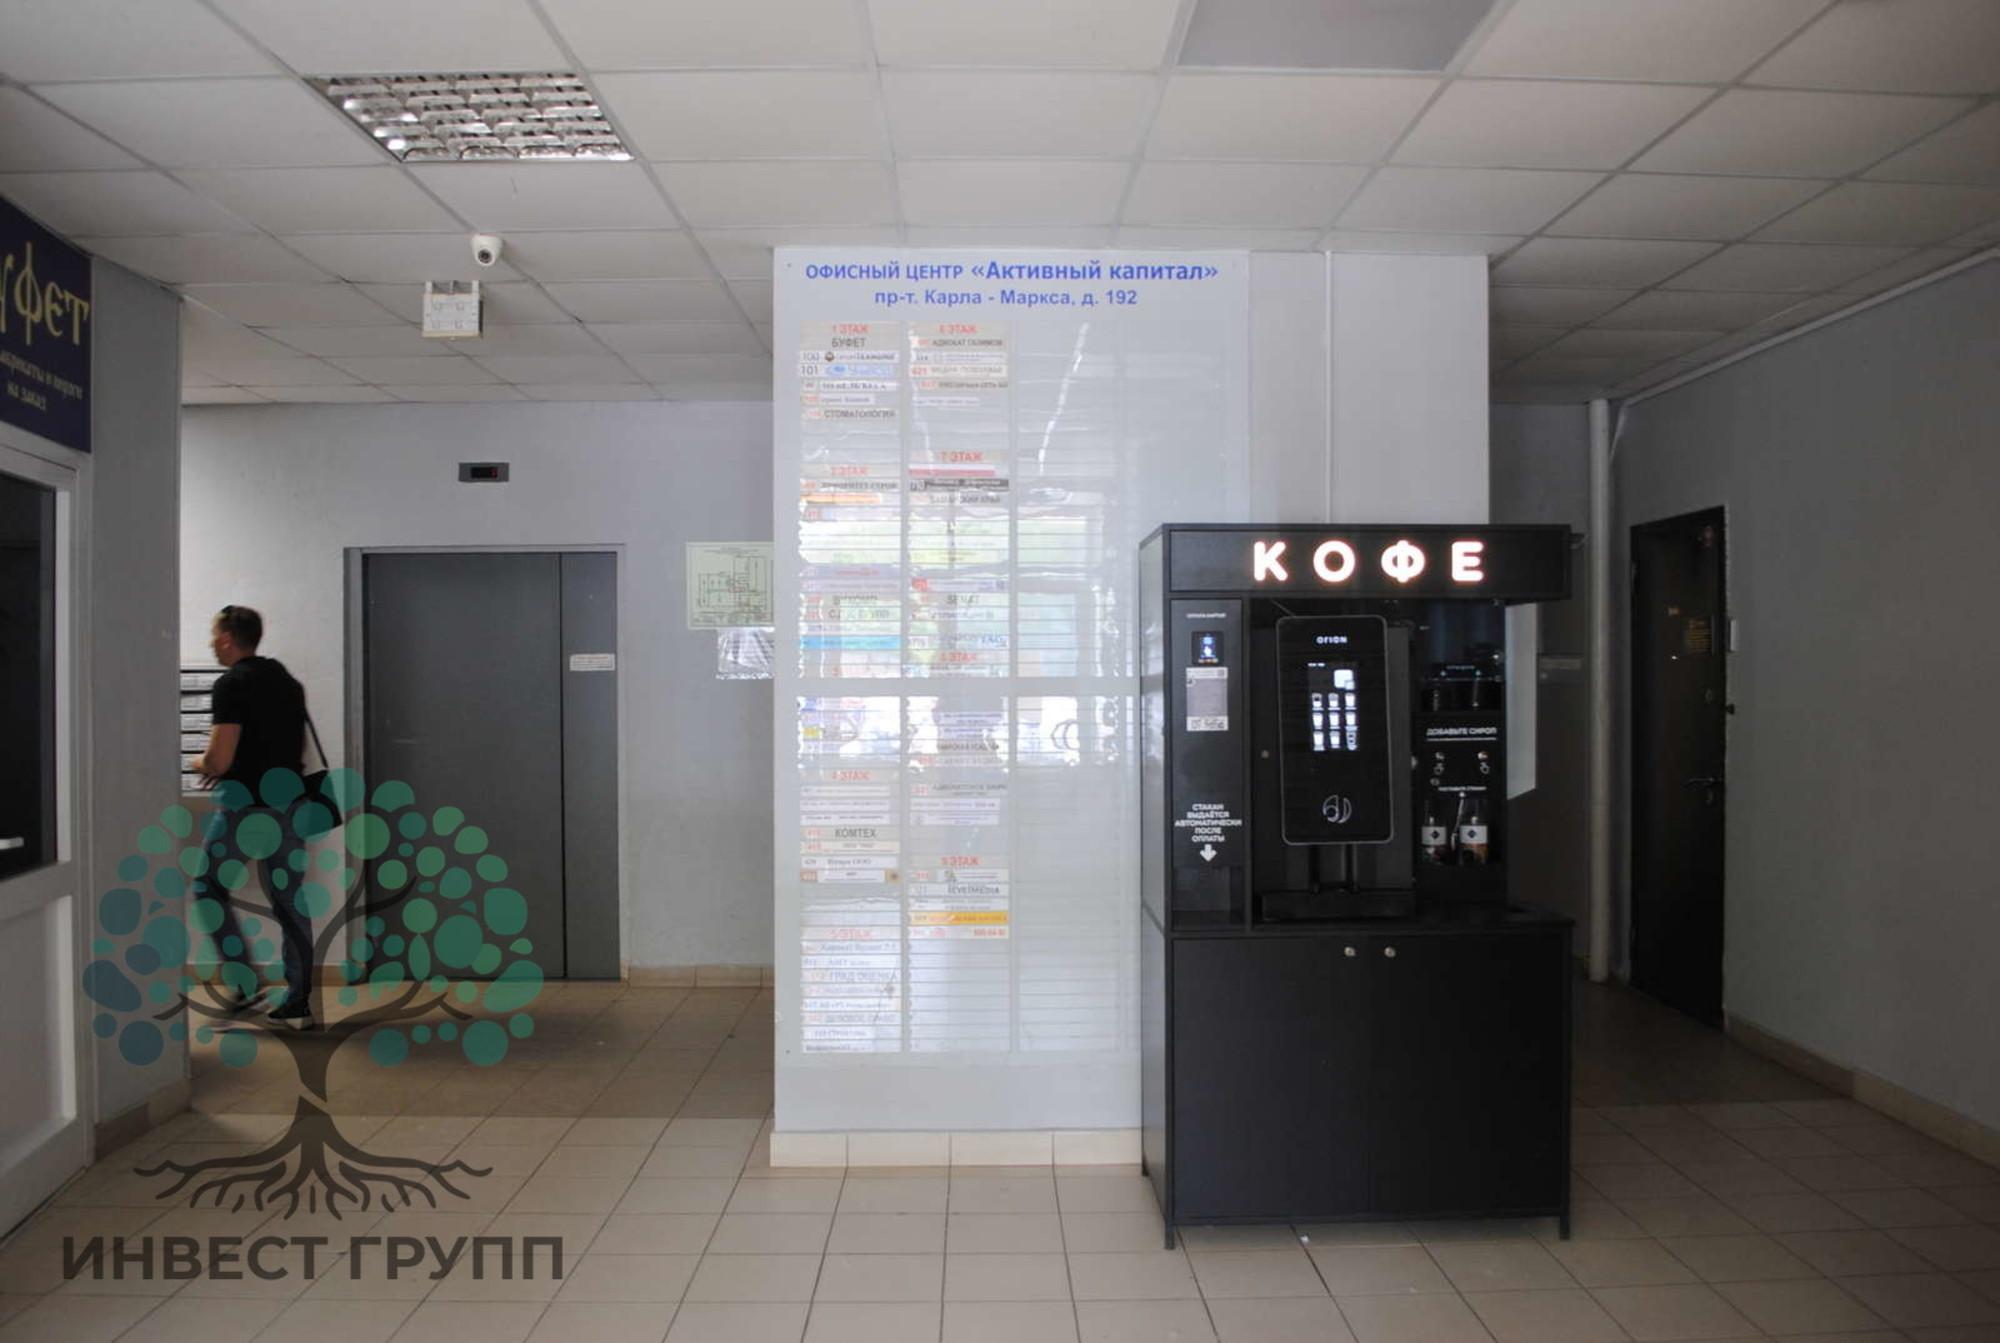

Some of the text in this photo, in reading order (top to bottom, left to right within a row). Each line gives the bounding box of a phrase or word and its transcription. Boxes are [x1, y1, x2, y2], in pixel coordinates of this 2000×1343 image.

[806, 261, 1219, 281] ОФИСНЫЙ ЦЕНТР «Активный капитал»
[874, 293, 919, 307] пр-т.
[925, 290, 982, 307] Карла
[1000, 290, 1076, 307] Маркса,
[1081, 292, 1099, 307] д.
[1107, 290, 1138, 305] 192
[831, 338, 866, 348] БУФЕТ
[823, 408, 897, 419] СТОМАТОЛОГИЯ
[1253, 540, 1485, 583] КОФЕ
[1469, 726, 1497, 735] СИРОП
[1192, 803, 1225, 811] СТАКАН
[1174, 819, 1243, 827] АВТОМАТИЧЕСКИ
[1194, 827, 1222, 835] ПОСЛЕ
[1191, 835, 1226, 843] ОПЛАТЫ
